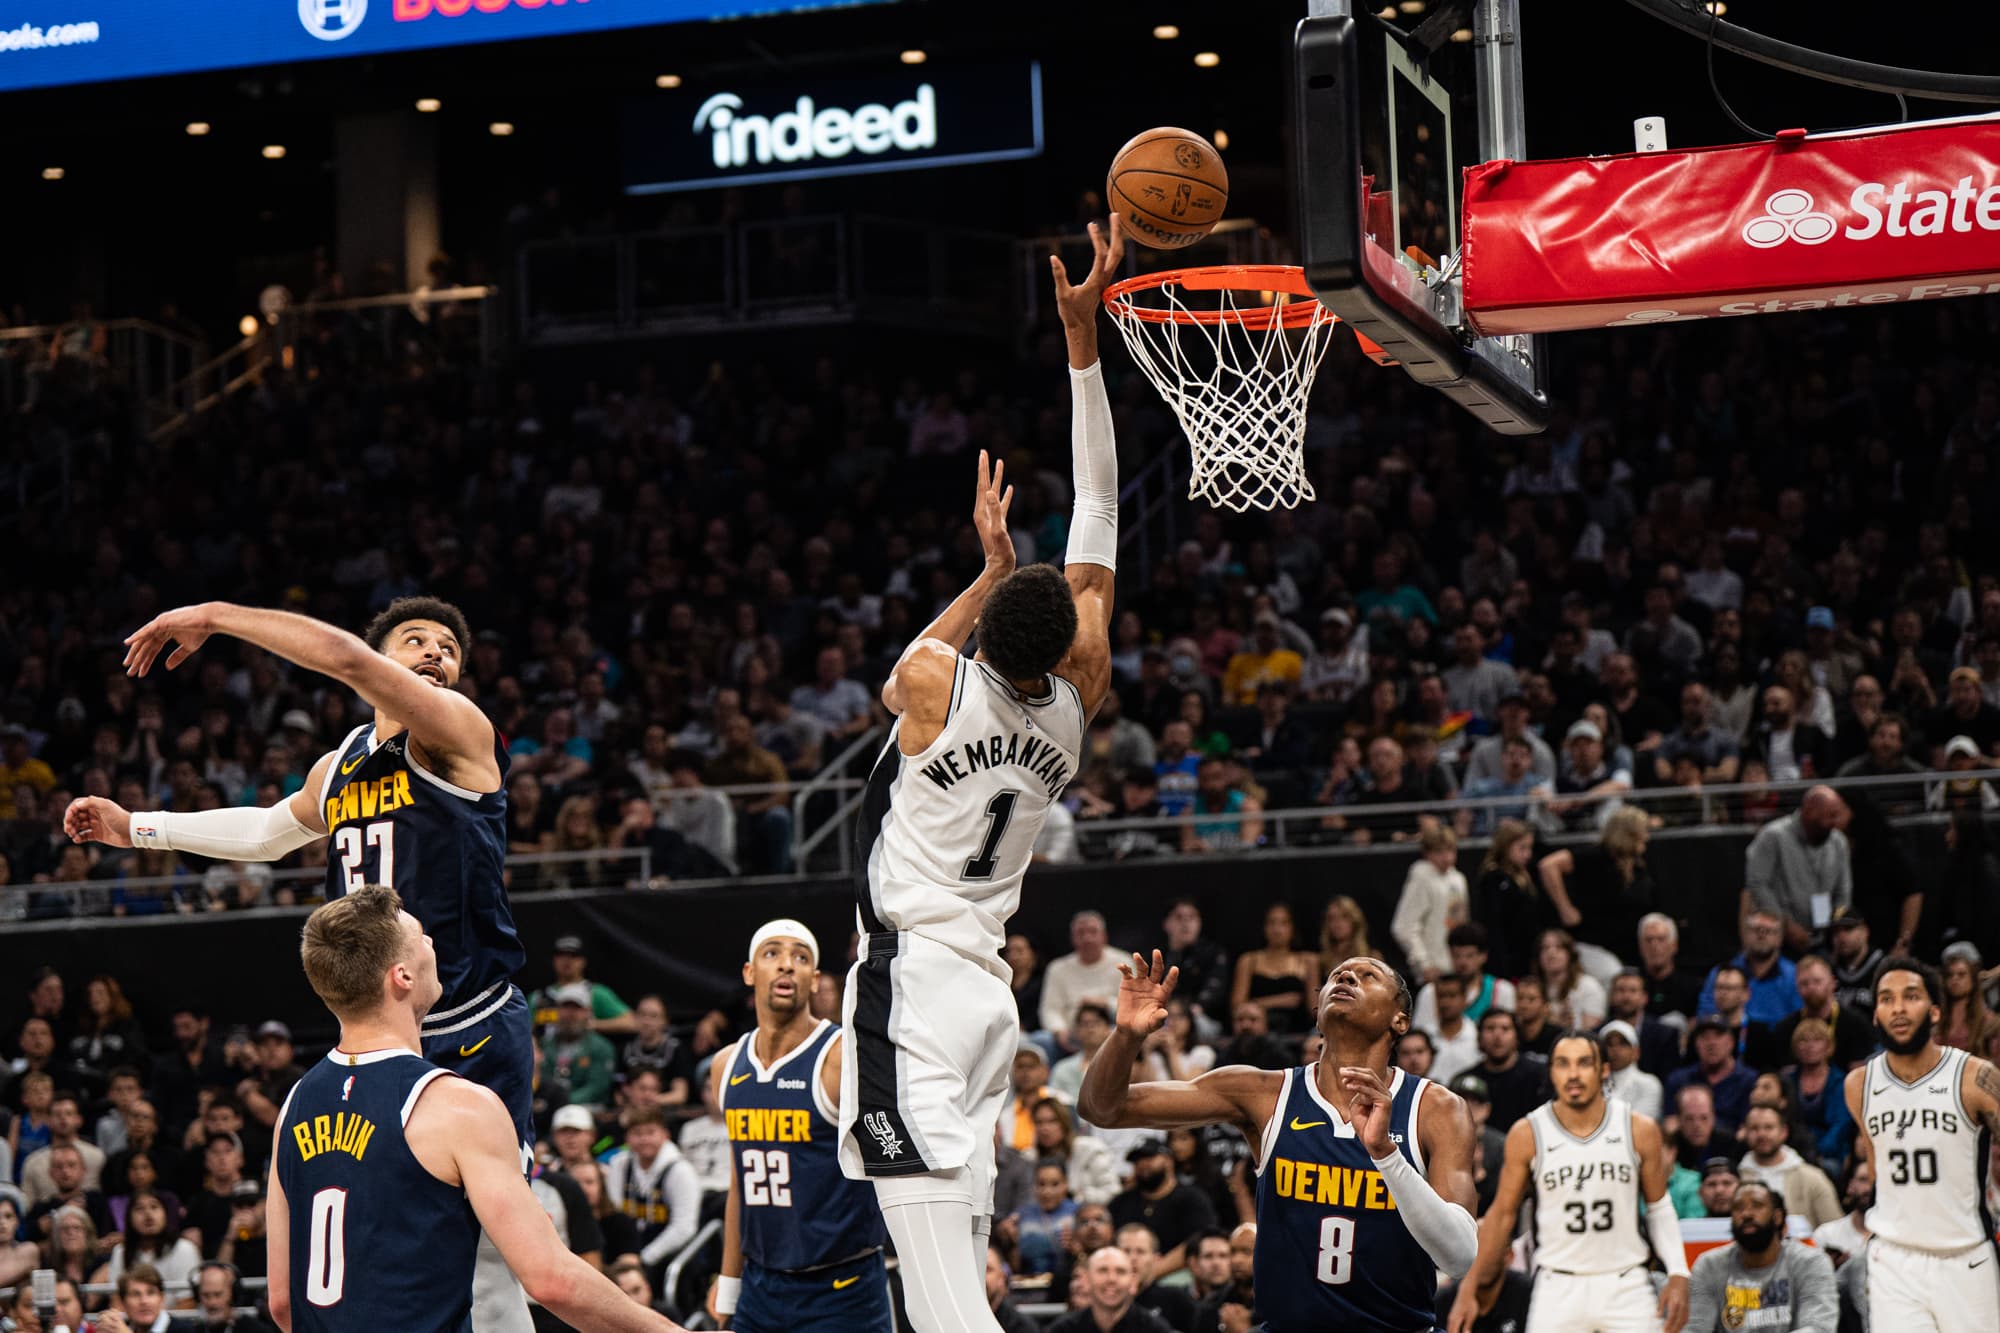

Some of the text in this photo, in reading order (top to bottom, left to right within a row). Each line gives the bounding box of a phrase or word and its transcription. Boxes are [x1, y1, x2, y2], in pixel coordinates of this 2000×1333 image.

[693, 84, 937, 168] indeed
[1844, 175, 2000, 241] State
[1719, 291, 1899, 318] State
[326, 769, 415, 836] DENVER
[335, 820, 395, 894] 27
[959, 788, 1021, 882] 1
[292, 1111, 376, 1162] BRAUN
[725, 1108, 813, 1143] DENVER
[741, 1149, 793, 1207] 22
[1275, 1157, 1397, 1211] DENVE
[1888, 1148, 1939, 1185] 30
[306, 1185, 348, 1309] 0
[1563, 1199, 1615, 1235] 33
[1316, 1215, 1356, 1285] 8
